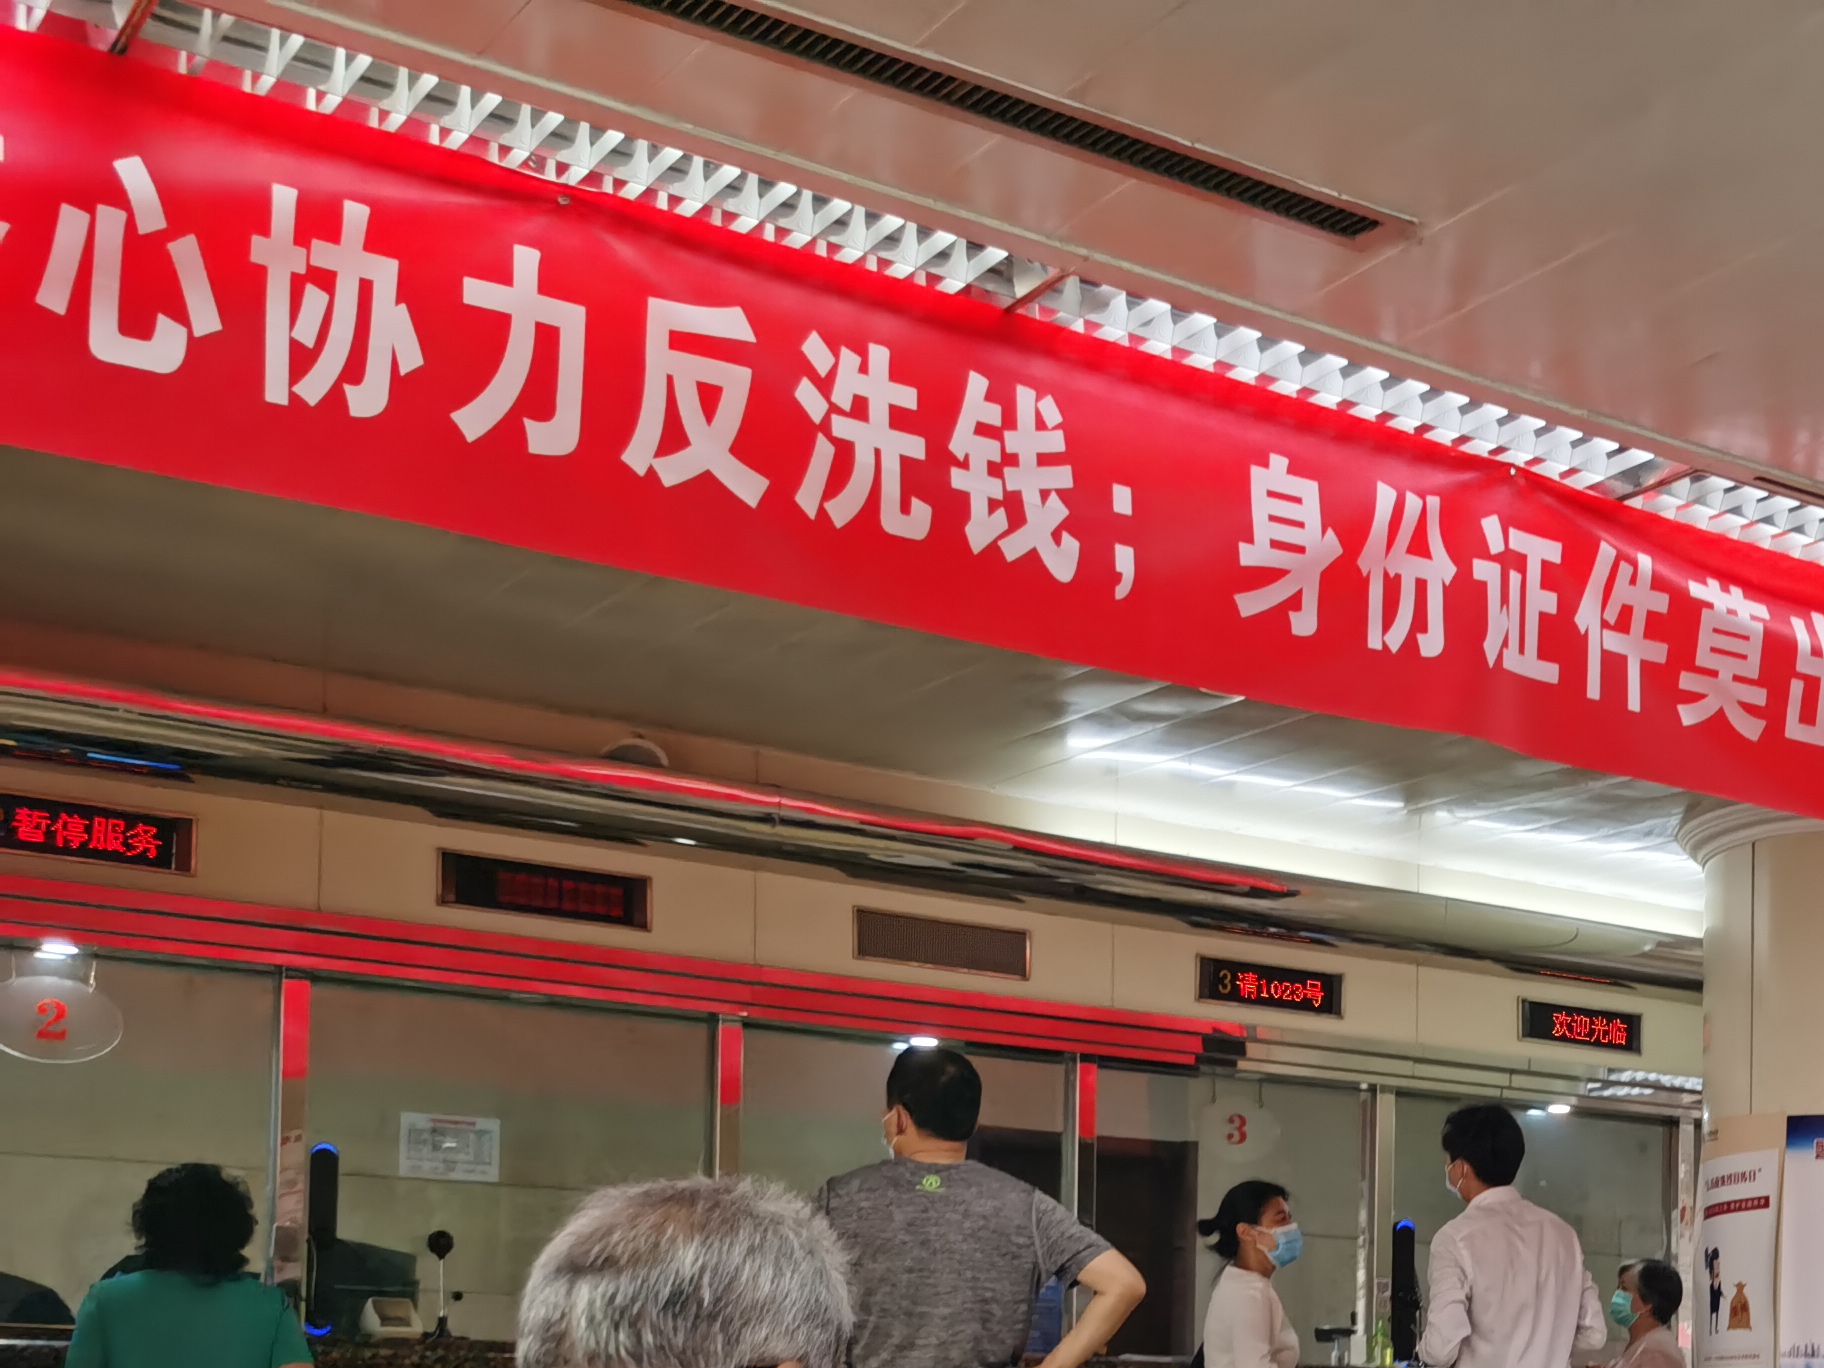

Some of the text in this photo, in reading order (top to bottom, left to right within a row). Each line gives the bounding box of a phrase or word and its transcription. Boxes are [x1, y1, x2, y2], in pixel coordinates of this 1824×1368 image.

[11, 807, 162, 858] 暂停服务
[1236, 971, 1324, 1008] 请1023号
[35, 998, 68, 1041] 2
[1552, 1011, 1628, 1046] 欢迎光临
[1227, 1113, 1247, 1145] 3
